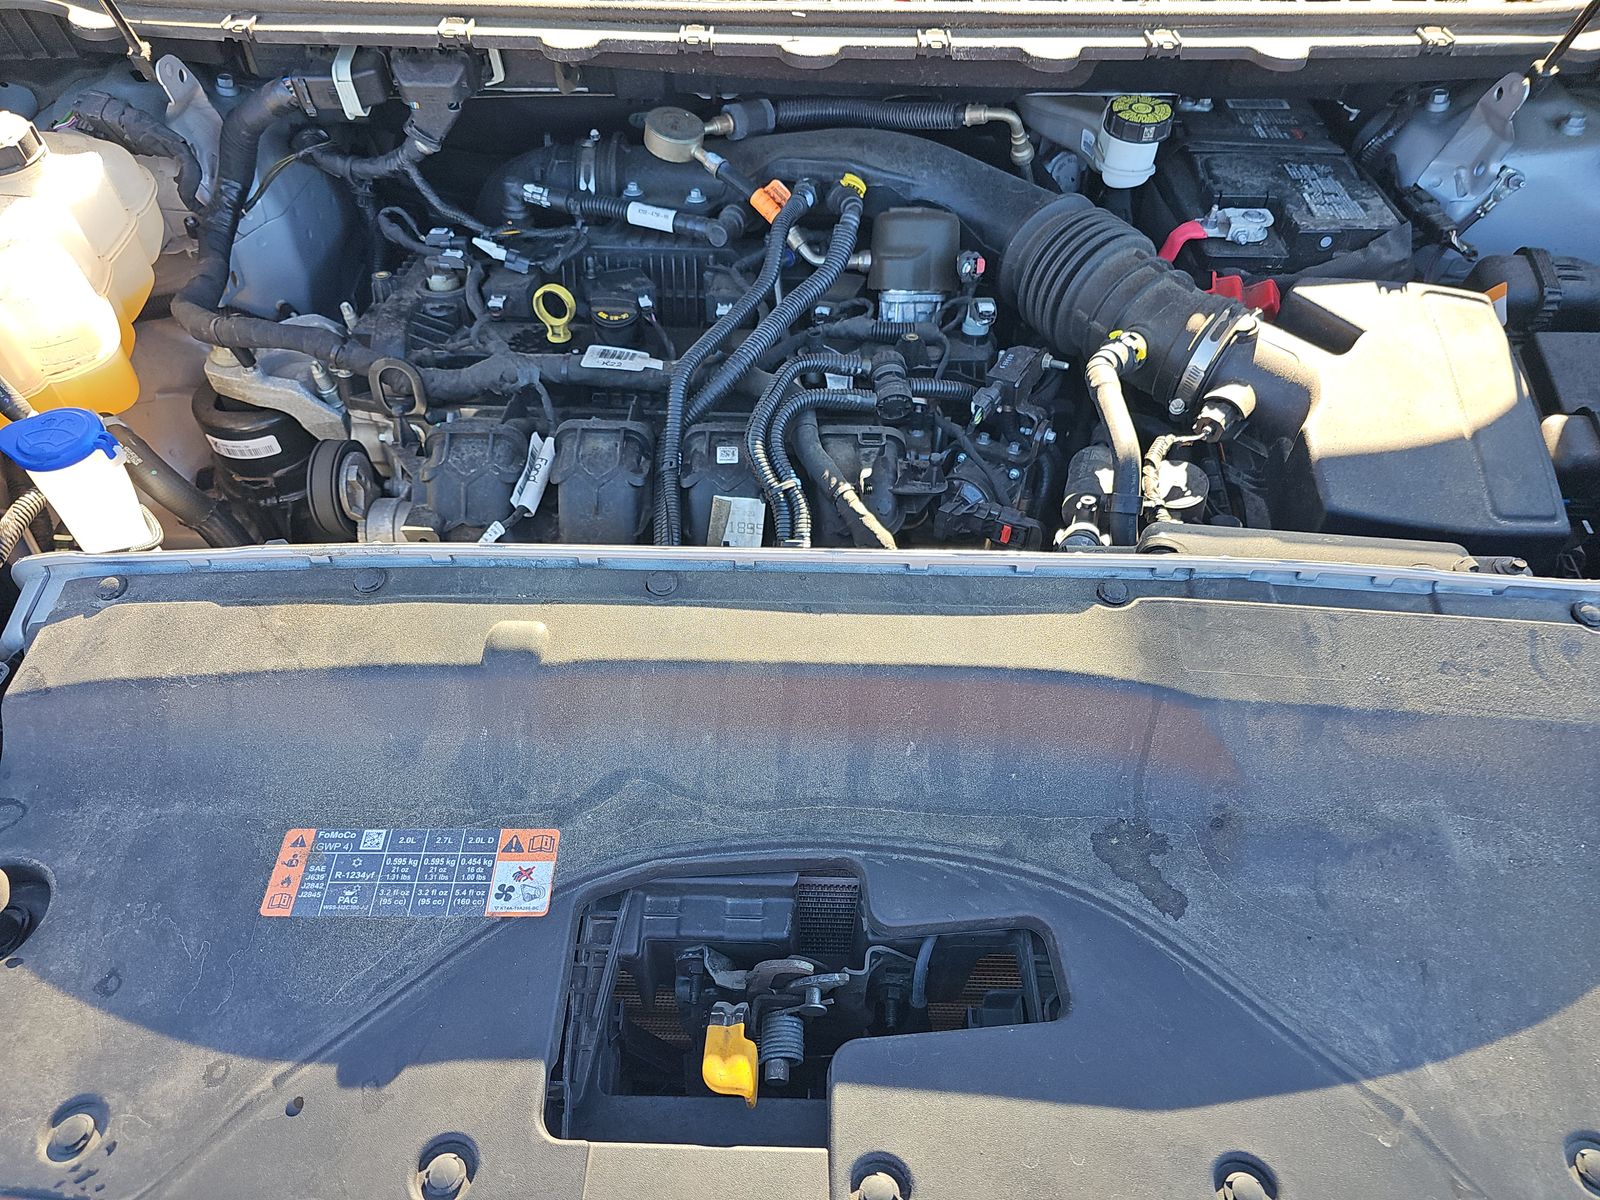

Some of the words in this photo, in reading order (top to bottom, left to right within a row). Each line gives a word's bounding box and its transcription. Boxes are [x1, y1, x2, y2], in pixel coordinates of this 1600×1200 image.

[318, 831, 357, 840] FoMoCo
[398, 836, 417, 844] 2.0L
[435, 836, 454, 844] 2.7L
[468, 836, 486, 844] 2.0L
[487, 836, 495, 844] D
[312, 842, 342, 852] (GWP
[342, 842, 354, 852] 4)
[386, 857, 407, 866] 0.595
[408, 857, 419, 868] kg
[423, 857, 445, 866] 0.595
[445, 857, 456, 868] kg
[460, 857, 482, 866] 0.454
[482, 857, 493, 868] kg
[304, 873, 326, 881] J639
[334, 871, 376, 881] R-1234yf
[337, 896, 358, 904] PAG
[379, 898, 392, 907] (95
[393, 898, 407, 907] cc)
[417, 898, 431, 907] (95
[432, 898, 445, 907] cc)
[453, 898, 471, 907] (160
[471, 898, 486, 907] cc)
